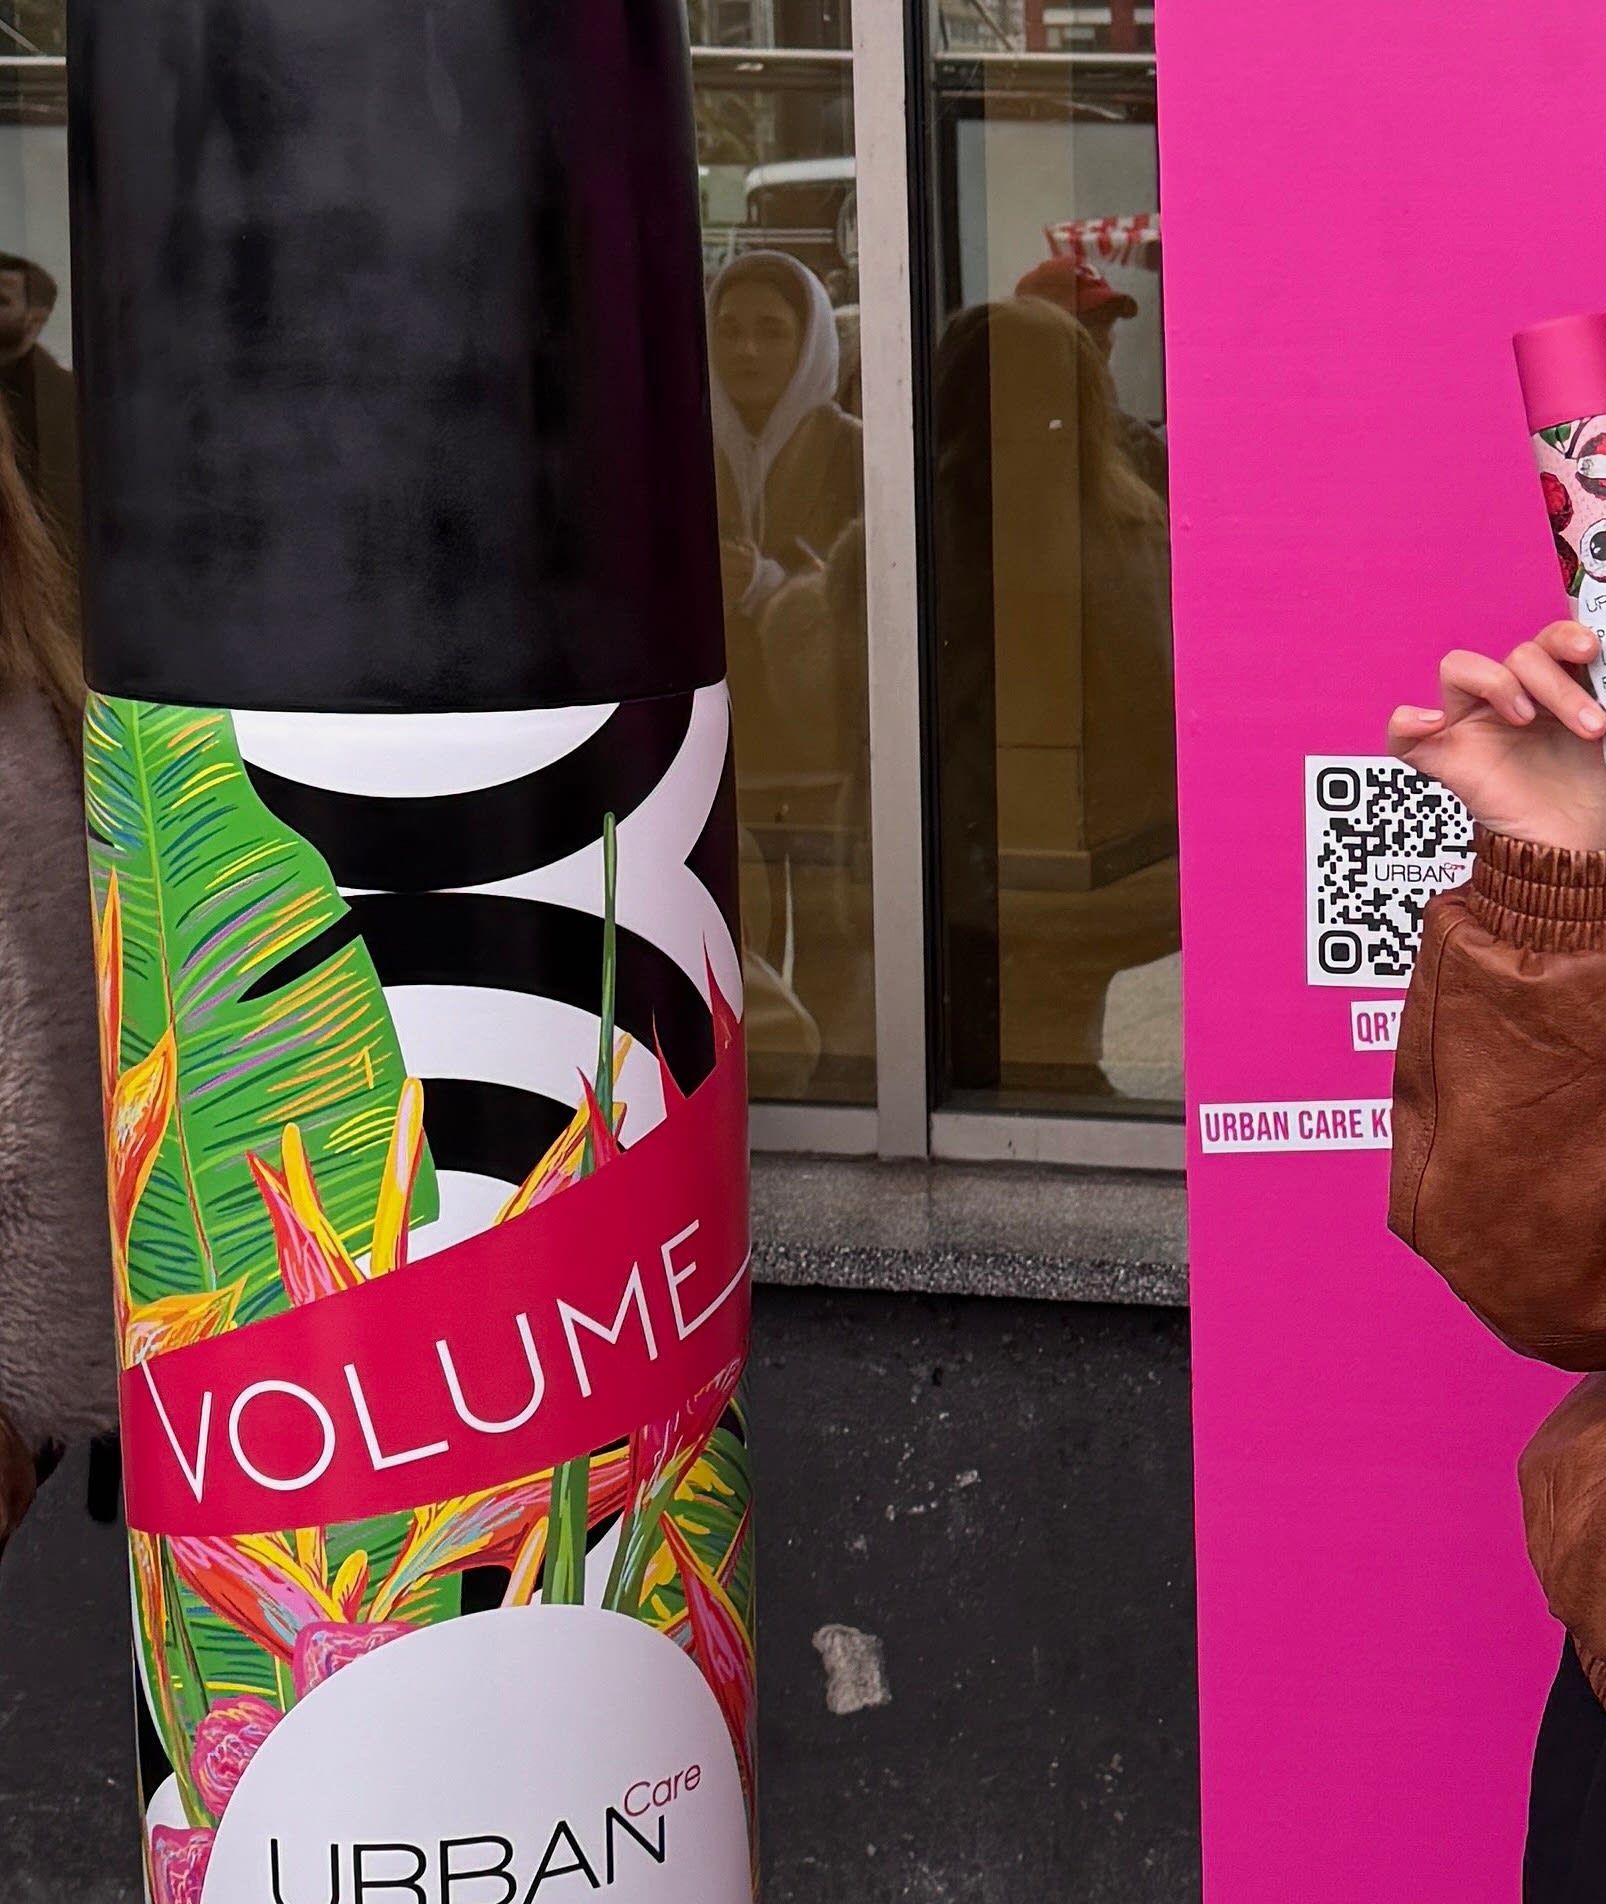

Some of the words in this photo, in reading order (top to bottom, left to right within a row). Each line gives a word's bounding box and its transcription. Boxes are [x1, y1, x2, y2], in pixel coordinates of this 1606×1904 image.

[1375, 863, 1454, 883] URBAN
[1357, 1011, 1397, 1043] QR'
[1205, 1111, 1289, 1142] URBAN
[1299, 1108, 1362, 1139] CARE
[133, 1219, 751, 1504] VOLUME
[623, 1763, 702, 1818] Care
